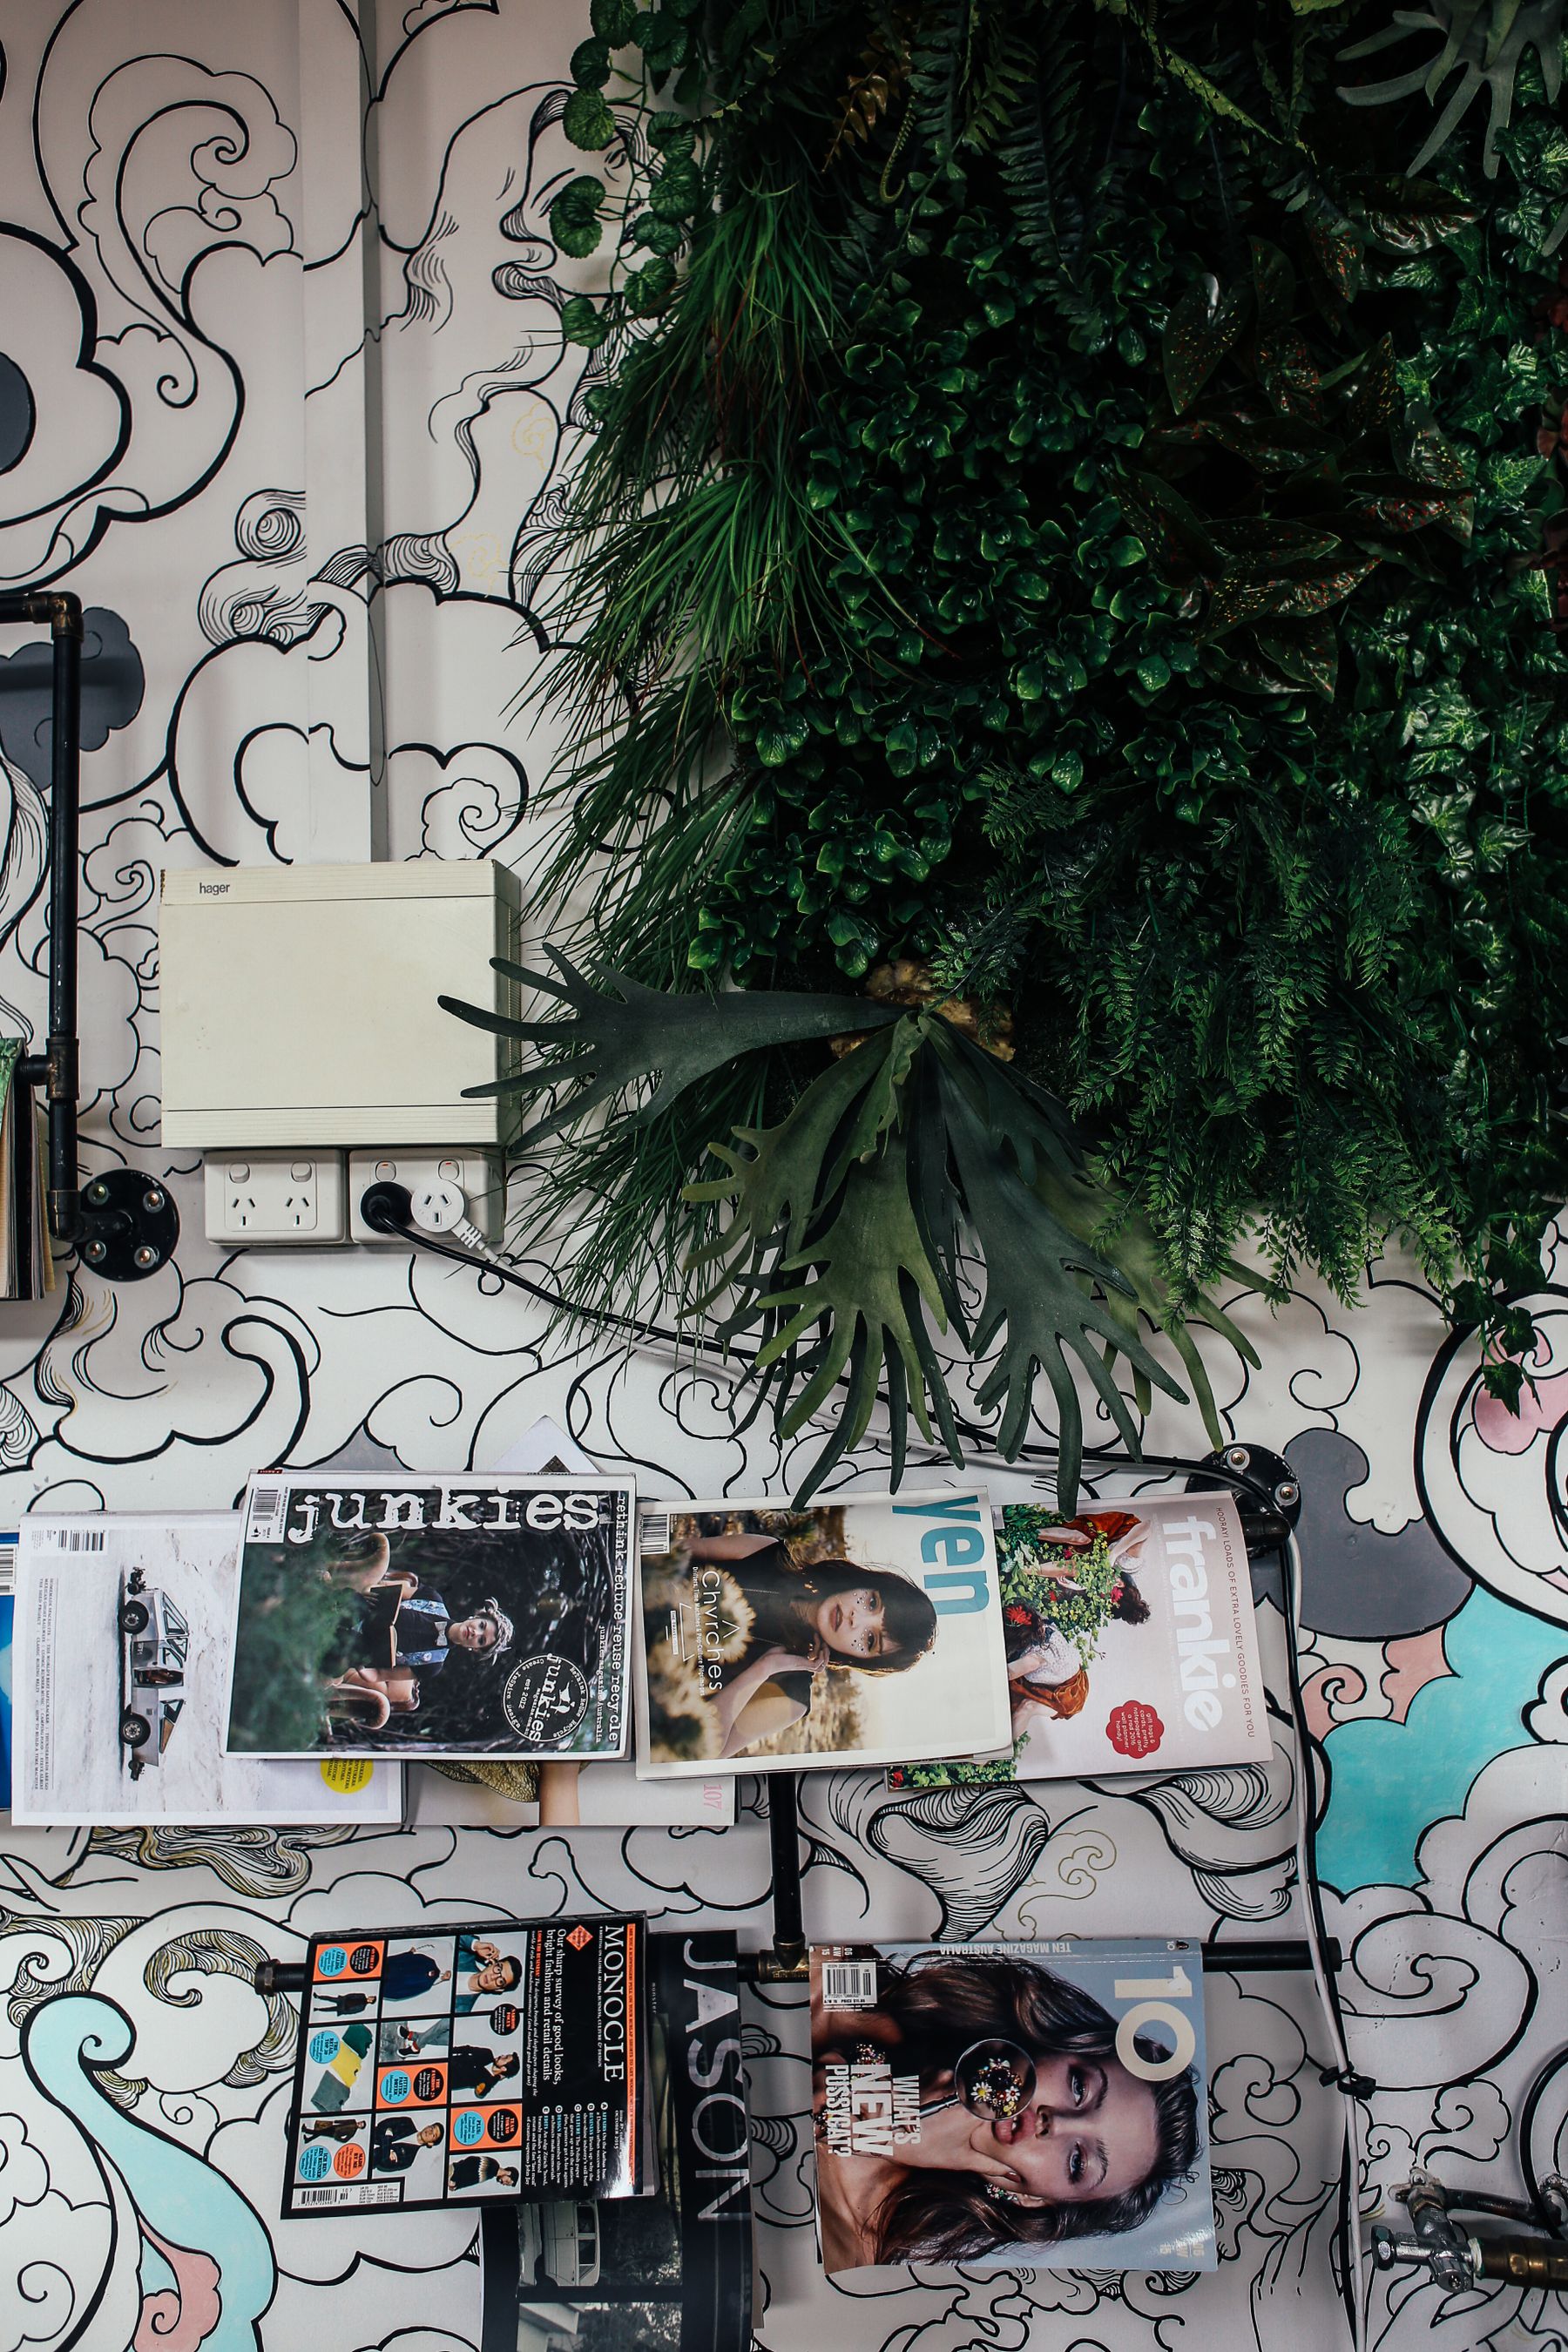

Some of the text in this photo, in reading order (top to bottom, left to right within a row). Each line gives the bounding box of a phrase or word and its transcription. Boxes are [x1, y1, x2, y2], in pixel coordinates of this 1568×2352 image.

[199, 882, 230, 896] hager
[287, 1484, 599, 1544] junkies
[615, 1497, 626, 1559] rethink
[892, 1496, 990, 1614] yen
[1223, 1540, 1233, 1568] LOADS
[613, 1565, 625, 1619] reduce
[1228, 1571, 1236, 1583] OF
[1230, 1586, 1239, 1614] EXTRA
[702, 1571, 724, 1690] Chvrches
[1163, 1516, 1236, 1731] frankie
[1233, 1618, 1243, 1650] LOVELY
[612, 1625, 622, 1670] reuse
[1238, 1653, 1249, 1694] GOODIES
[518, 1692, 528, 1709] 2012
[529, 1653, 562, 1741] junkies
[704, 1784, 723, 1810] 107
[544, 1930, 556, 1957] bright
[833, 1947, 841, 1957] AW
[939, 1943, 1071, 1955] TEN MAGAZINE AUSTRALIA
[1166, 1942, 1175, 1950] 10
[544, 1960, 554, 1994] fashion
[544, 1997, 552, 2015] and
[552, 1929, 566, 2085] Our sharp survey of good looks,
[604, 1925, 625, 2082] MONOCLE
[1114, 1965, 1196, 2081] 10
[543, 2047, 552, 2080] details
[683, 1938, 750, 2221] JASON
[824, 2064, 851, 2157] PUSSYCAT?
[851, 2064, 894, 2157] NEW
[892, 2075, 921, 2145] WHAT'S
